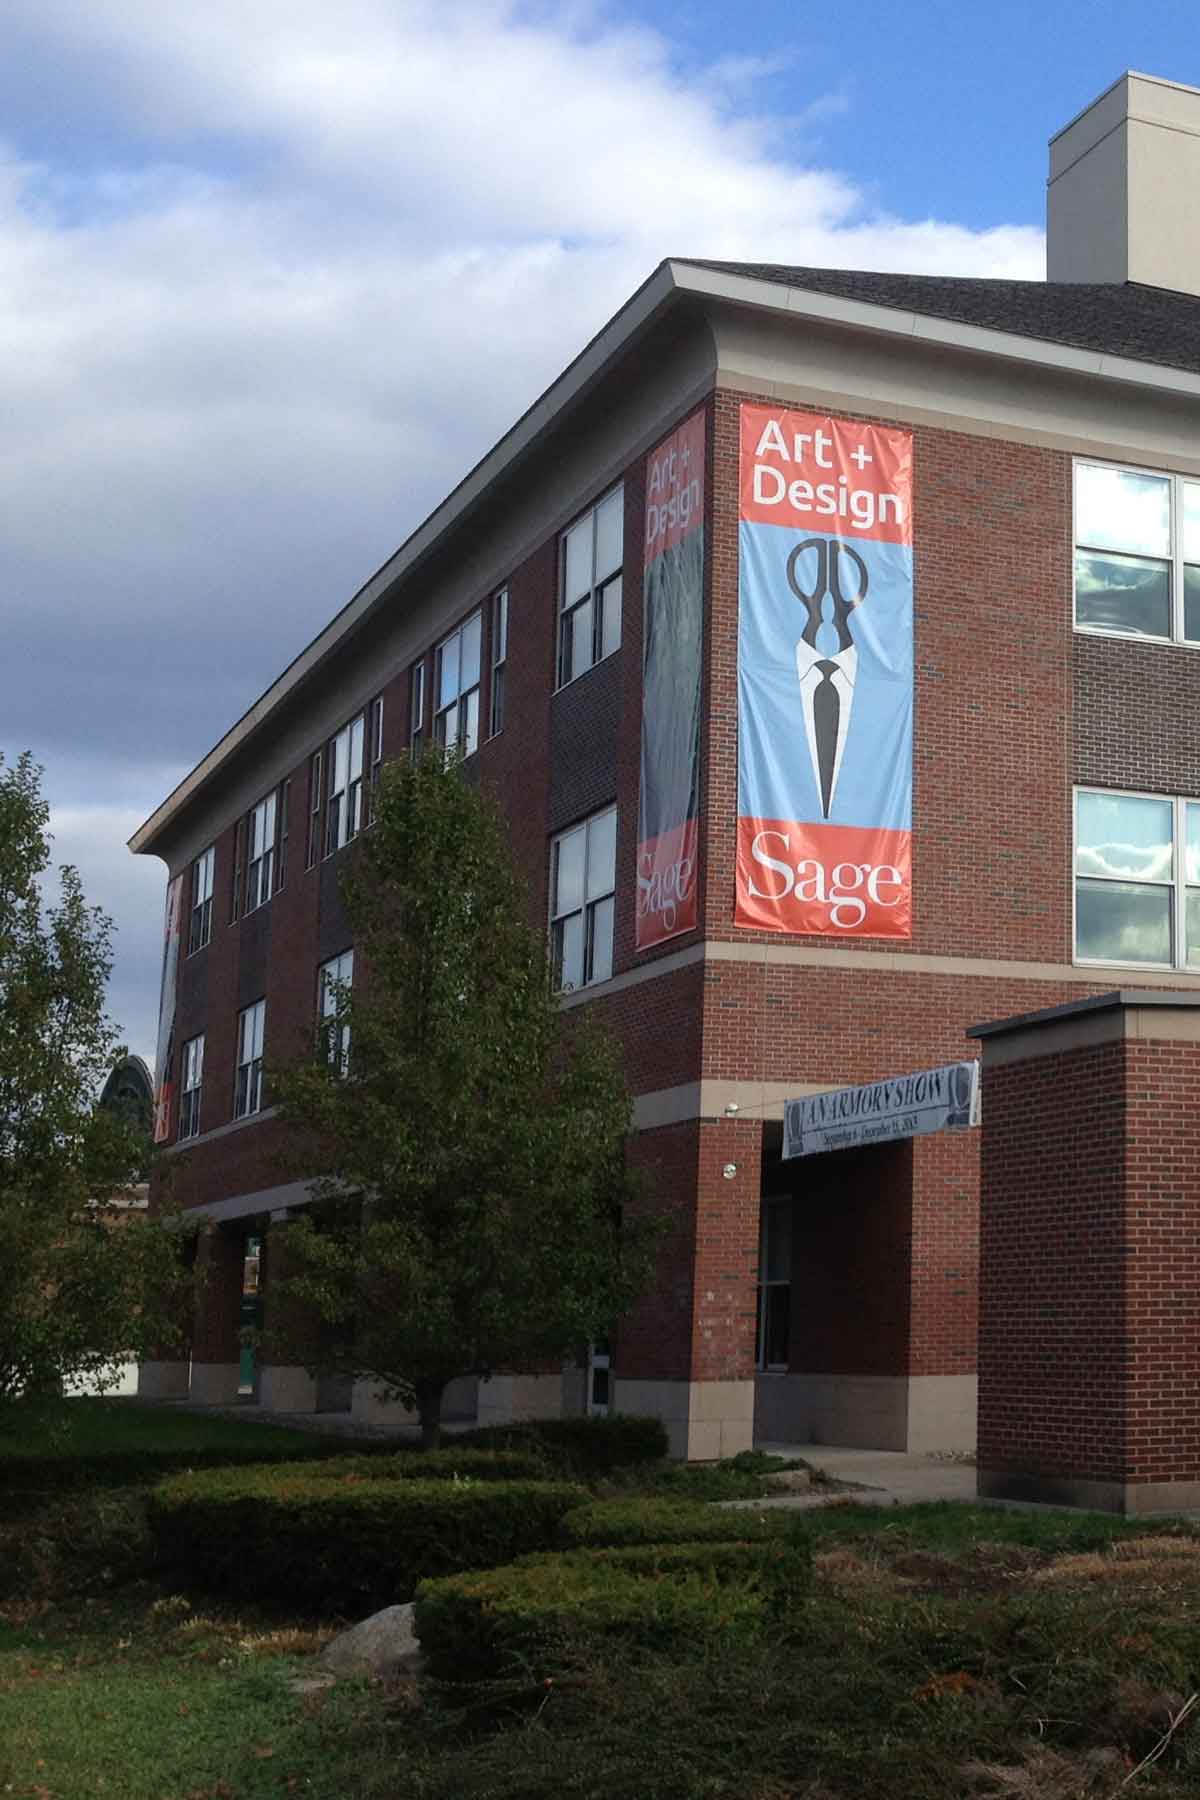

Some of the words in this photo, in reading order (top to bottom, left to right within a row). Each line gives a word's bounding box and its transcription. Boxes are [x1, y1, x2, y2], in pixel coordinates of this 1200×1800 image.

[650, 449, 680, 496] Art
[754, 420, 833, 468] Art
[646, 479, 700, 545] Design
[752, 463, 905, 529] Design
[637, 853, 693, 932] Sage
[748, 831, 903, 928] Sage
[831, 1082, 896, 1121] ARMORY
[894, 1071, 945, 1107] SHOW
